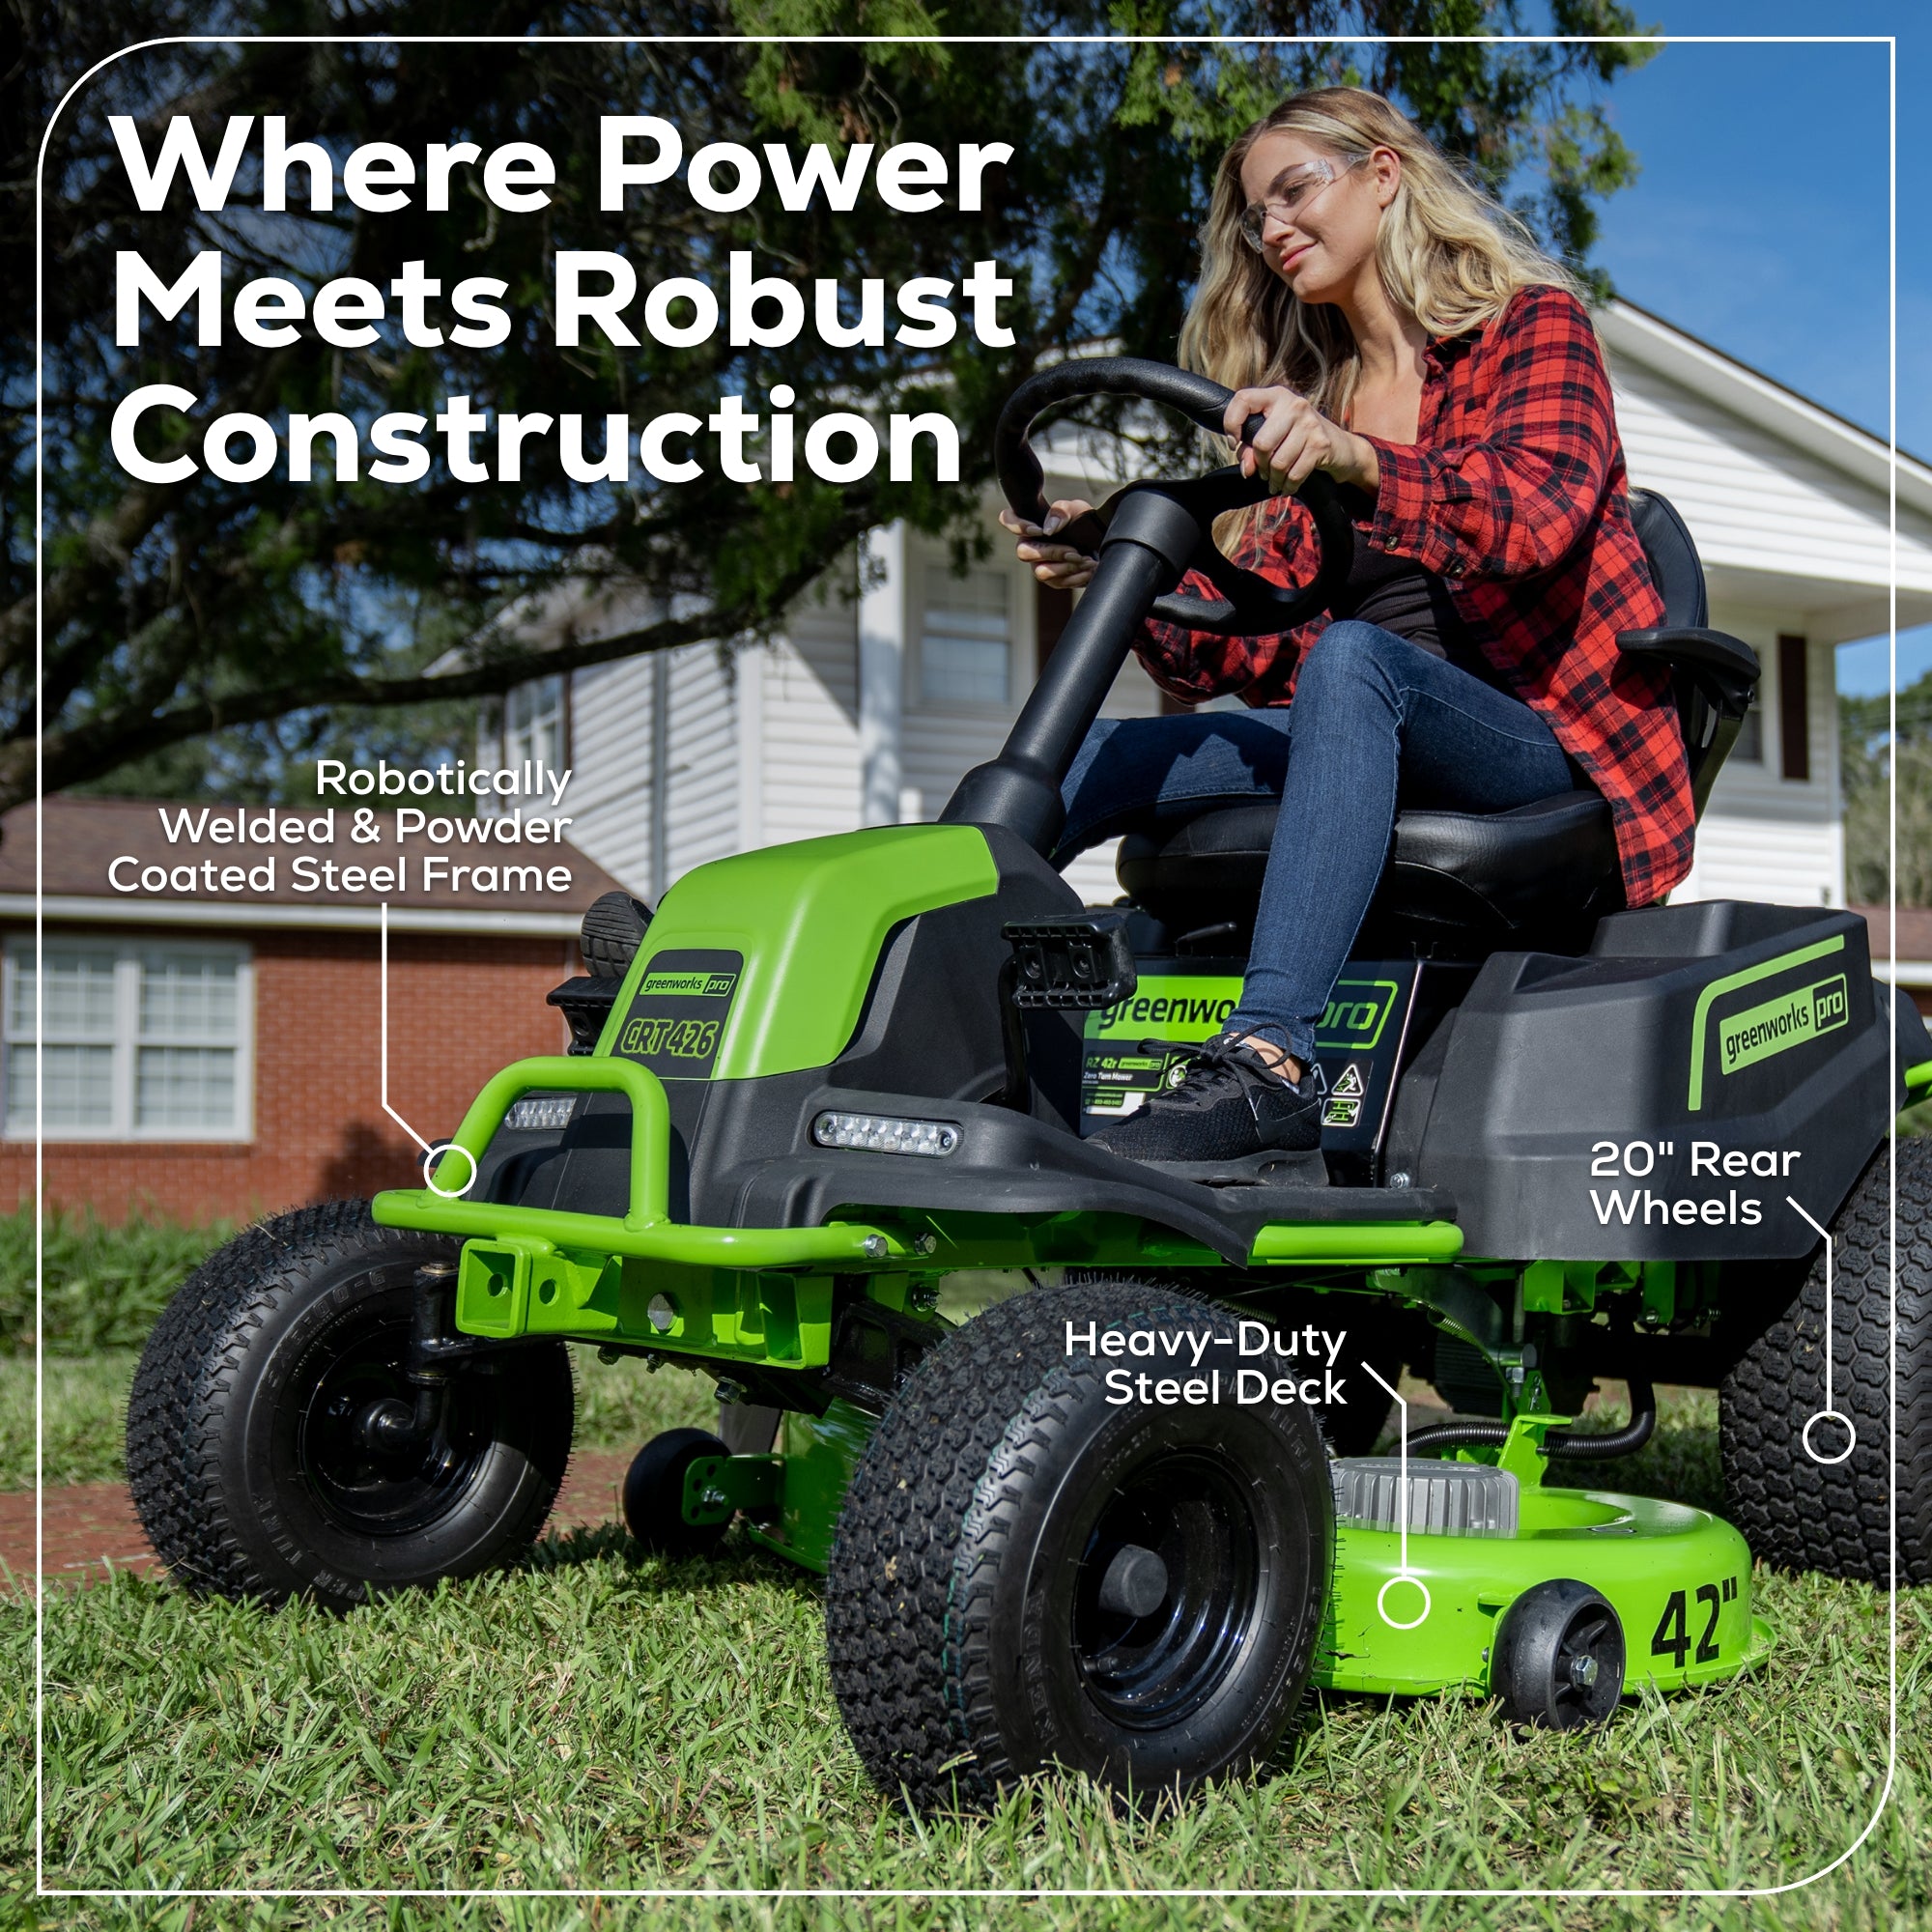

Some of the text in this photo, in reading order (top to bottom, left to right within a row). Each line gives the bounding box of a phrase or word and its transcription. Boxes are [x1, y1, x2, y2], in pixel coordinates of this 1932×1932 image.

[644, 977, 730, 993] greenworks pro
[1098, 997, 1236, 1031] greenwo
[1726, 990, 1844, 1065] greenworks pro
[620, 1017, 721, 1060] CRT 426
[1083, 1070, 1134, 1082] Zero Turn Mower
[1086, 1057, 1100, 1068] RZ
[1650, 1576, 1738, 1669] 42"
[1022, 1589, 1060, 1748] KENDA
